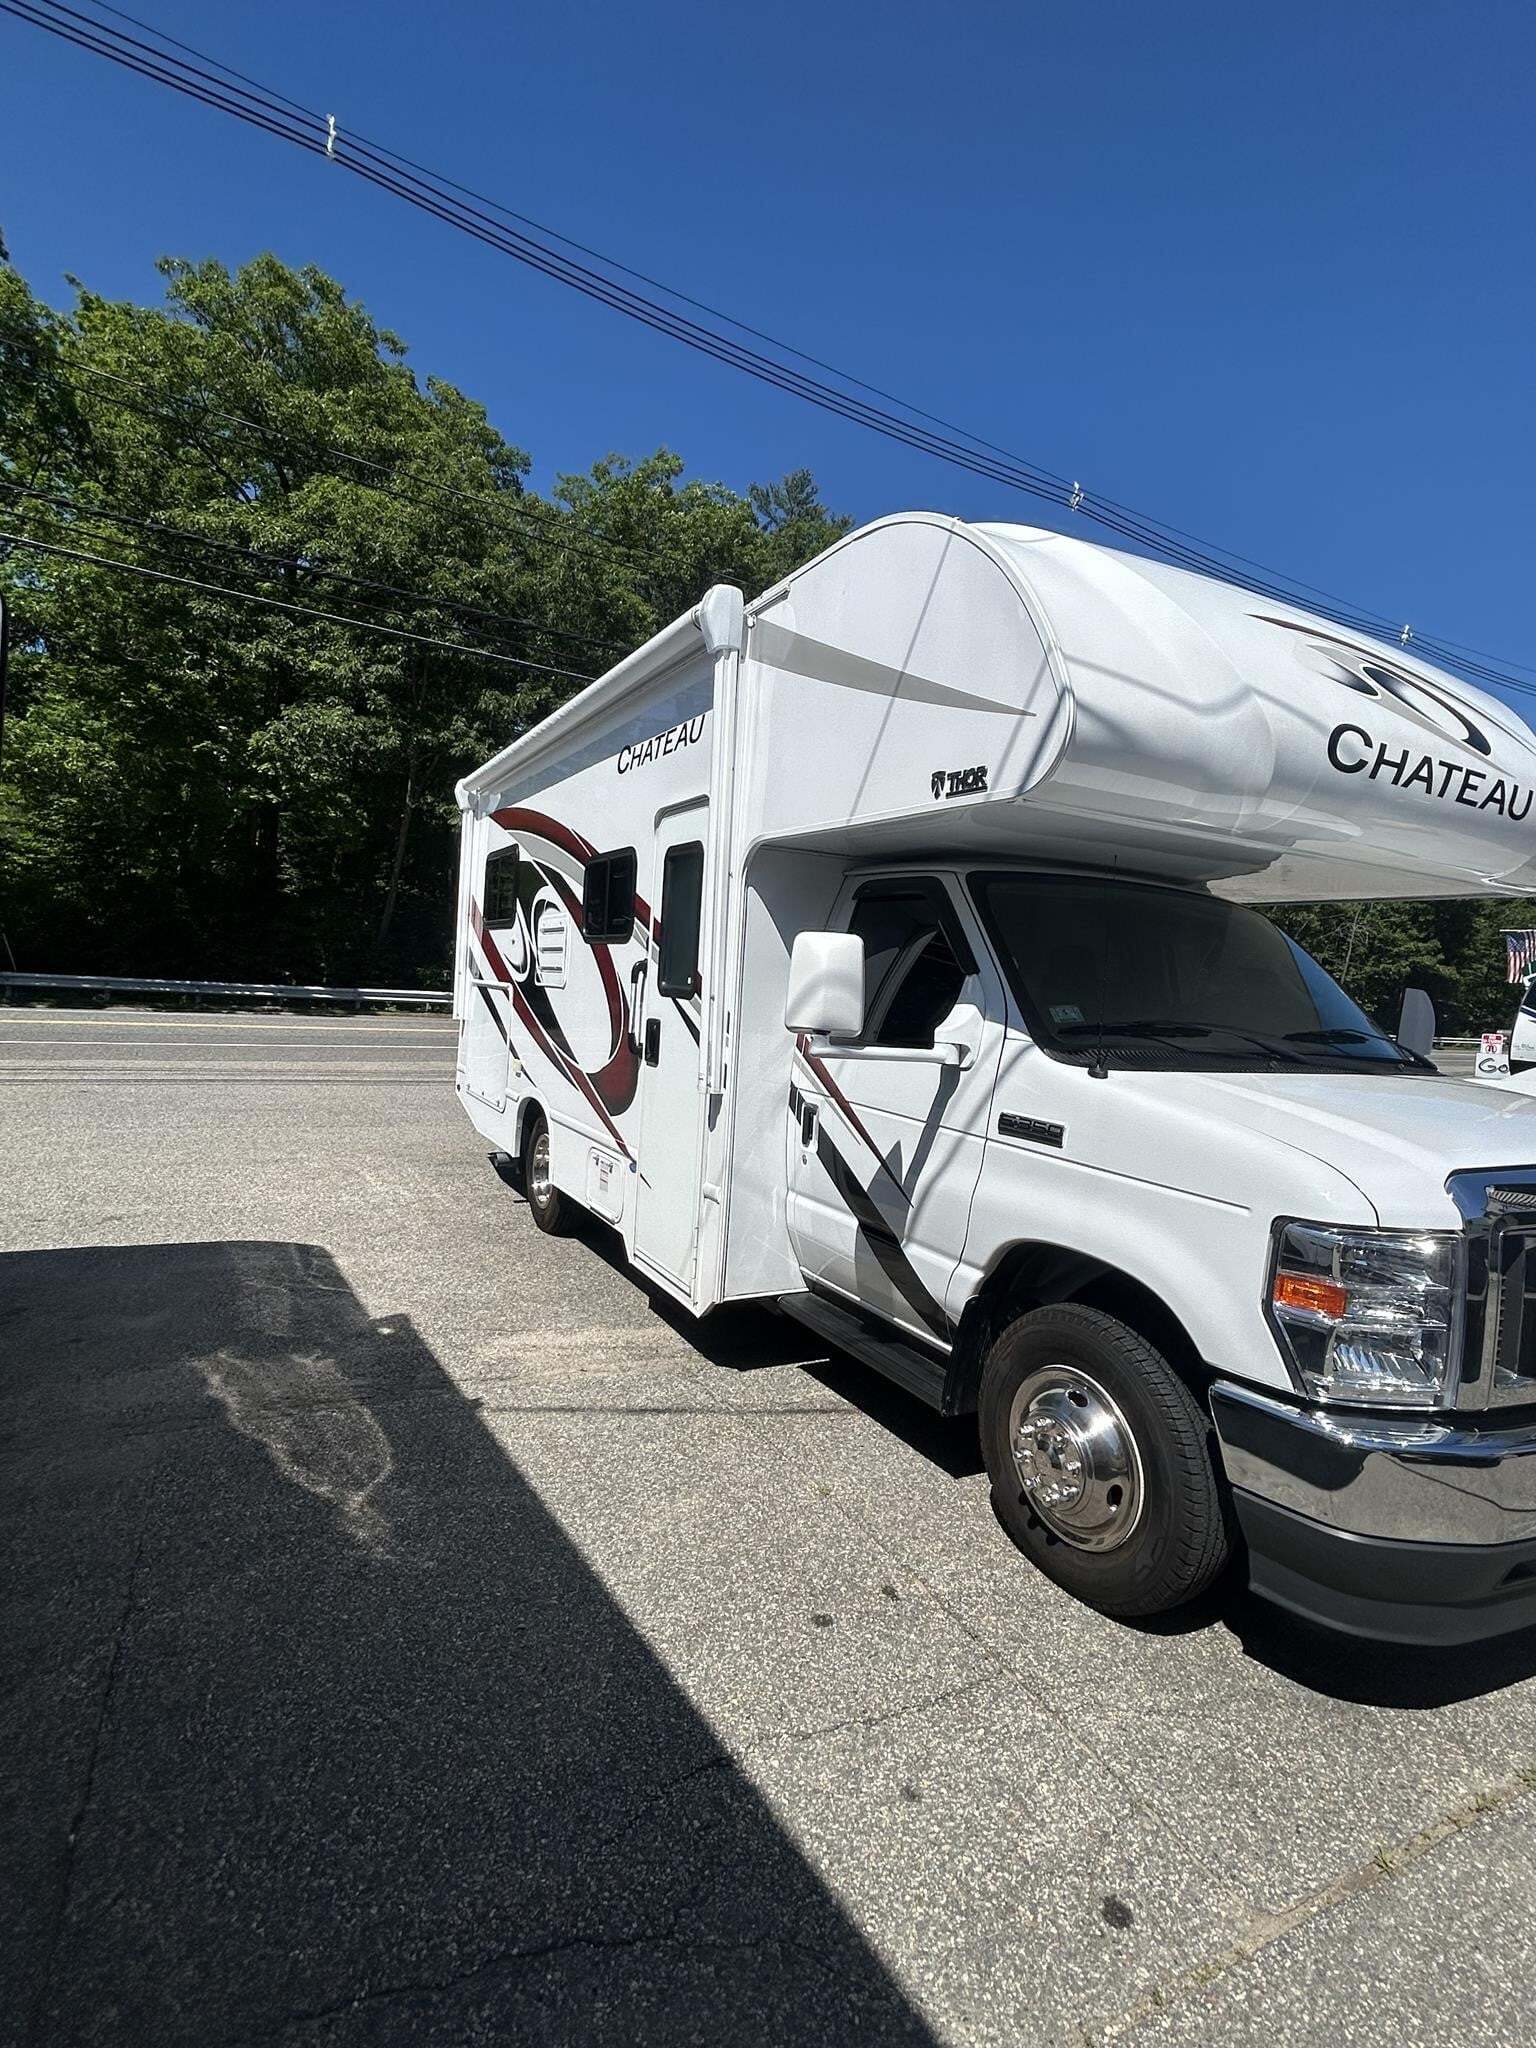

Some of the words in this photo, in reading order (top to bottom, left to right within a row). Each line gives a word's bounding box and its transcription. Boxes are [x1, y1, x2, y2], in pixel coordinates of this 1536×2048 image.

[617, 713, 706, 775] CHATEAU
[1327, 723, 1534, 821] CHATEAU
[946, 765, 988, 793] THOR
